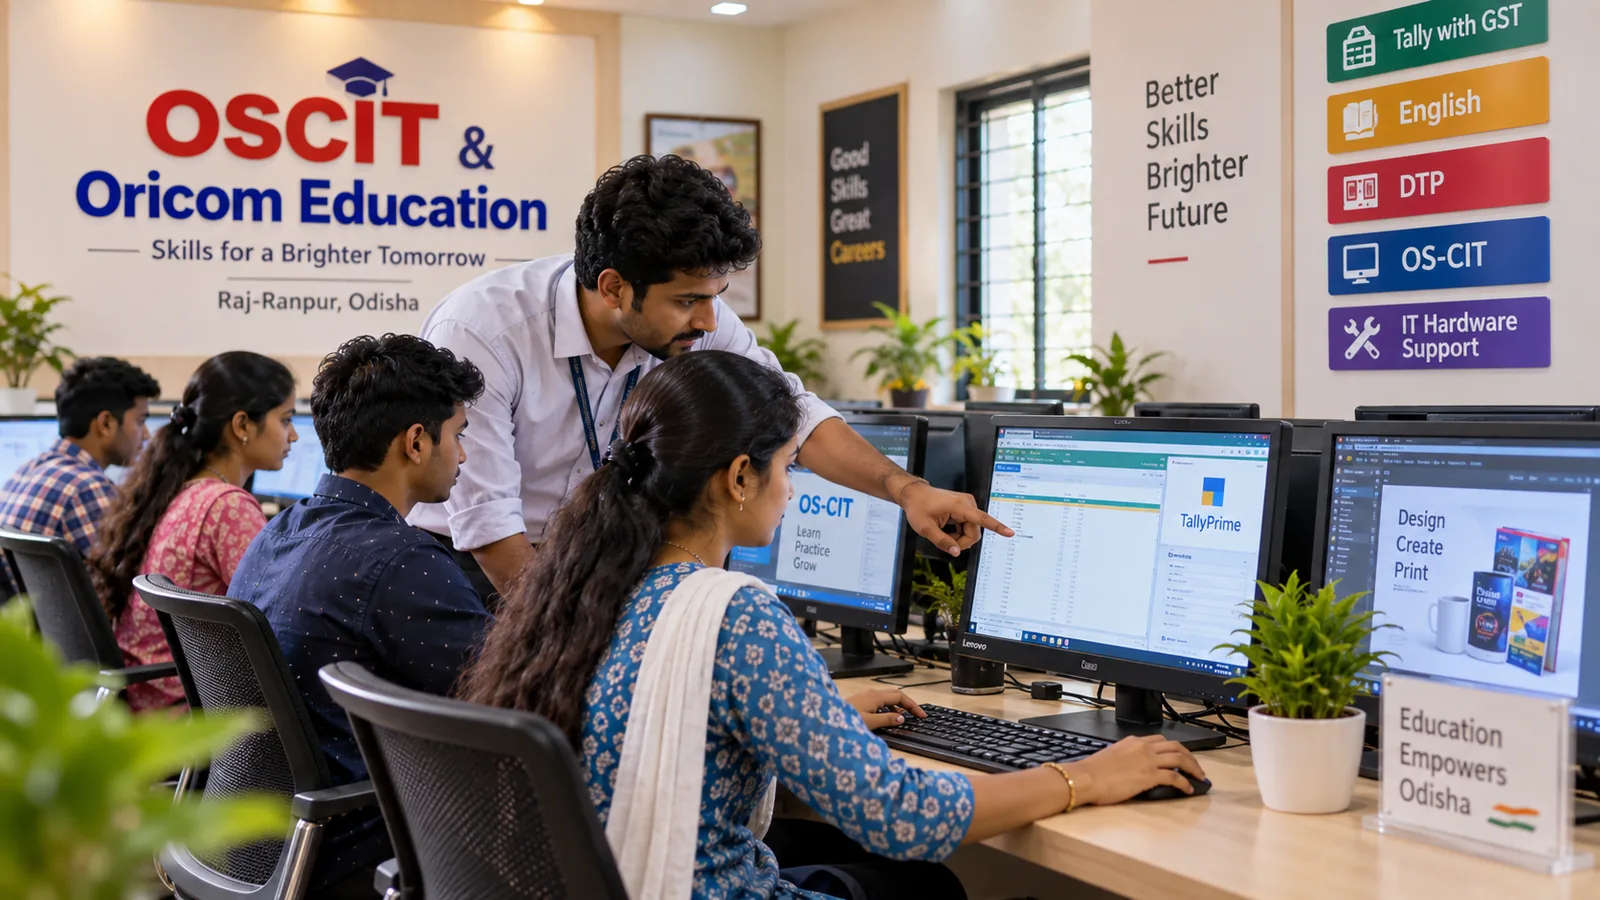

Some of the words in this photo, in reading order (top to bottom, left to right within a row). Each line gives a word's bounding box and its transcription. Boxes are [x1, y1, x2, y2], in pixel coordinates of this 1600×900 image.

[1393, 25, 1432, 51] Tally
[1437, 15, 1476, 43] with
[1481, 3, 1523, 32] GST
[1146, 72, 1220, 109] Better
[1400, 89, 1481, 126] English
[146, 89, 439, 166] OSCIT
[458, 125, 494, 169] &
[1146, 111, 1209, 150] Skills
[830, 141, 869, 171] Good
[1147, 153, 1248, 193] Brighter
[1400, 170, 1444, 198] DTP
[75, 170, 282, 222] Oricom
[299, 178, 548, 231] Education
[830, 174, 869, 203] Skills
[830, 206, 872, 234] Great
[1148, 201, 1228, 231] Future
[151, 239, 213, 261] Skills
[221, 241, 254, 262] for
[261, 247, 273, 262] a
[281, 243, 371, 268] Brighter
[378, 245, 486, 267] Tomorrow
[830, 239, 886, 265] Careers
[1402, 241, 1488, 272] OS-CIT
[218, 290, 342, 315] Raj-Ranpur,
[348, 290, 419, 312] Odisha
[1402, 315, 1418, 334] IT
[1424, 312, 1518, 334] Hardware
[1402, 337, 1479, 362] Support
[799, 494, 854, 518] OS-CIT
[1398, 508, 1446, 532] Design
[797, 525, 821, 540] Learn
[1180, 513, 1242, 532] TallyPrime
[795, 541, 830, 557] Practice
[1396, 535, 1444, 556] Create
[793, 556, 817, 572] Grow
[1394, 561, 1429, 581] Print
[1400, 706, 1503, 748] Education
[1400, 742, 1508, 787] Empowers
[1399, 778, 1471, 816] Odisha
